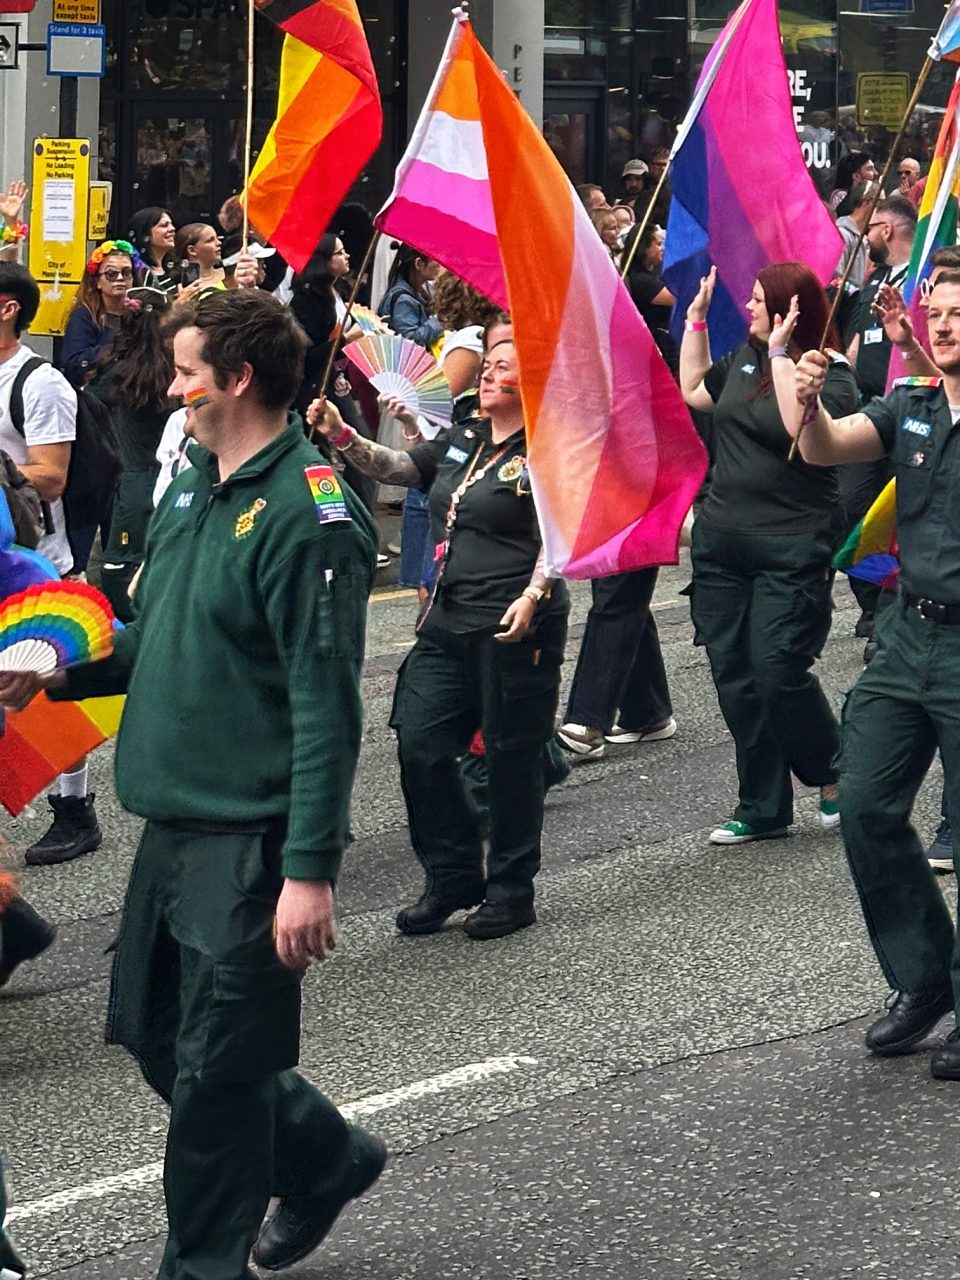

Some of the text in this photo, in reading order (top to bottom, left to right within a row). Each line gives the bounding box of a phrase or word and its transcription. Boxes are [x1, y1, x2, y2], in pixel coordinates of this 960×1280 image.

[57, 2, 65, 11] At
[56, 12, 78, 20] except
[50, 24, 69, 34] Stand
[71, 25, 80, 33] for
[88, 26, 104, 35] taxis
[51, 140, 71, 148] Parking
[55, 172, 74, 180] Parking
[47, 261, 58, 269] City
[903, 418, 931, 436] NHS
